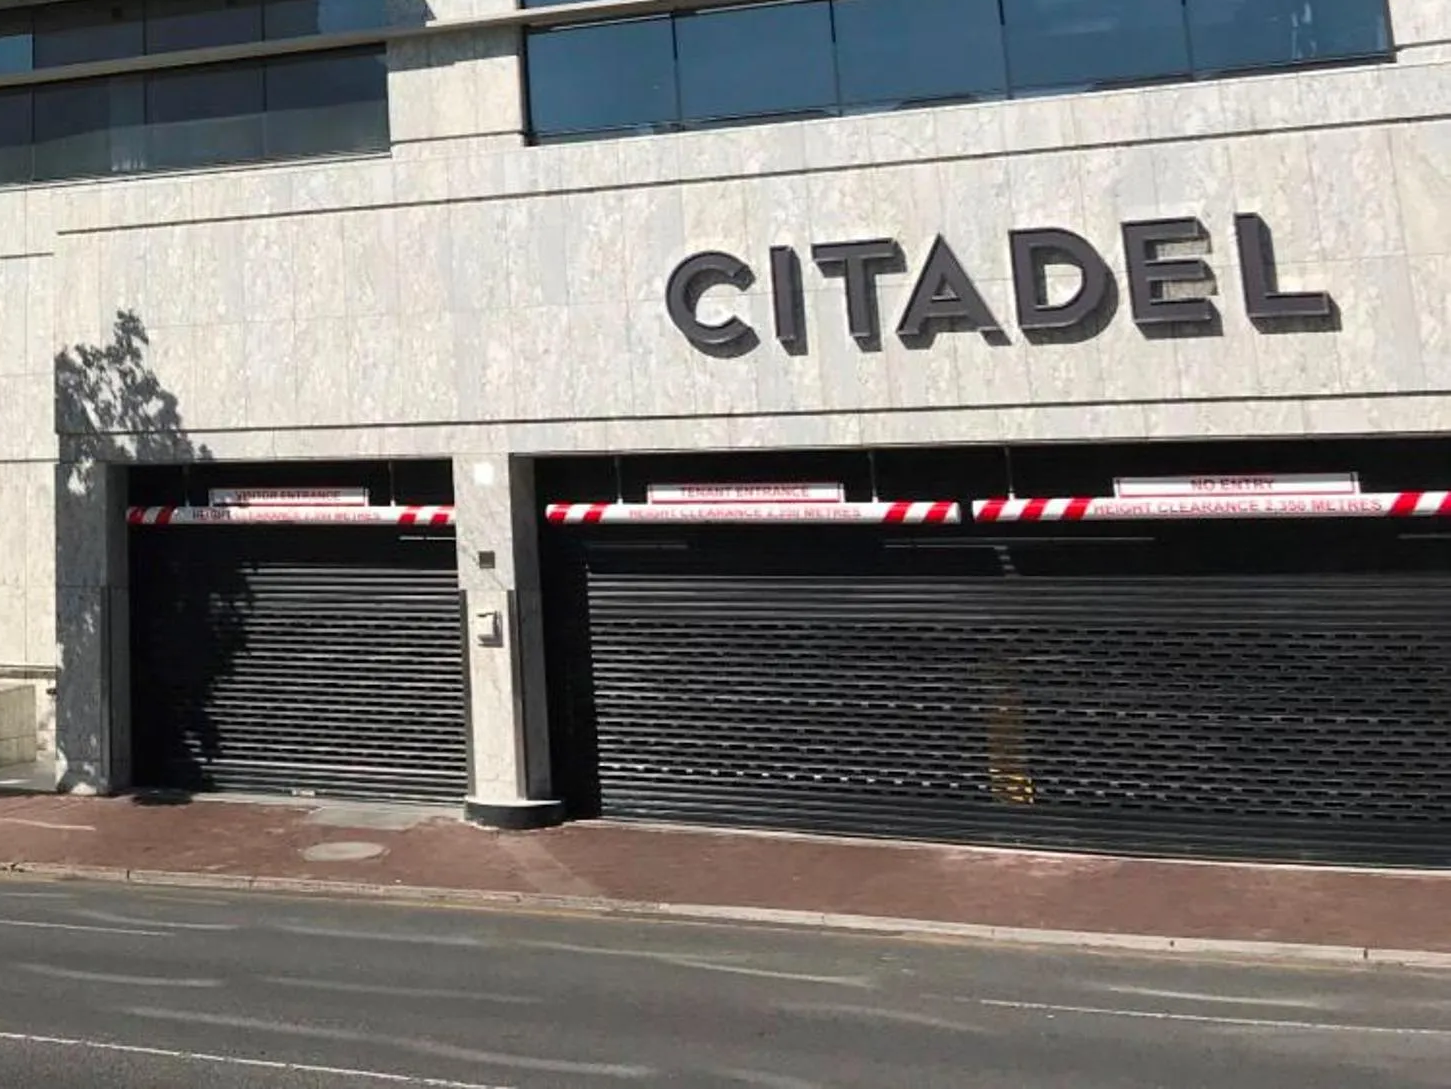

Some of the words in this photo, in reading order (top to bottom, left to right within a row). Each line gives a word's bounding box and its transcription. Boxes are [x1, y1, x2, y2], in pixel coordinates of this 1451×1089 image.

[665, 211, 1343, 358] CITADEL
[736, 486, 810, 498] ENTRANCE
[1190, 479, 1216, 492] NO
[1220, 478, 1276, 492] ENTRY
[1094, 503, 1152, 516] HEIGHT
[1160, 500, 1258, 514] CLEARANCE
[1311, 498, 1382, 512] METRES
